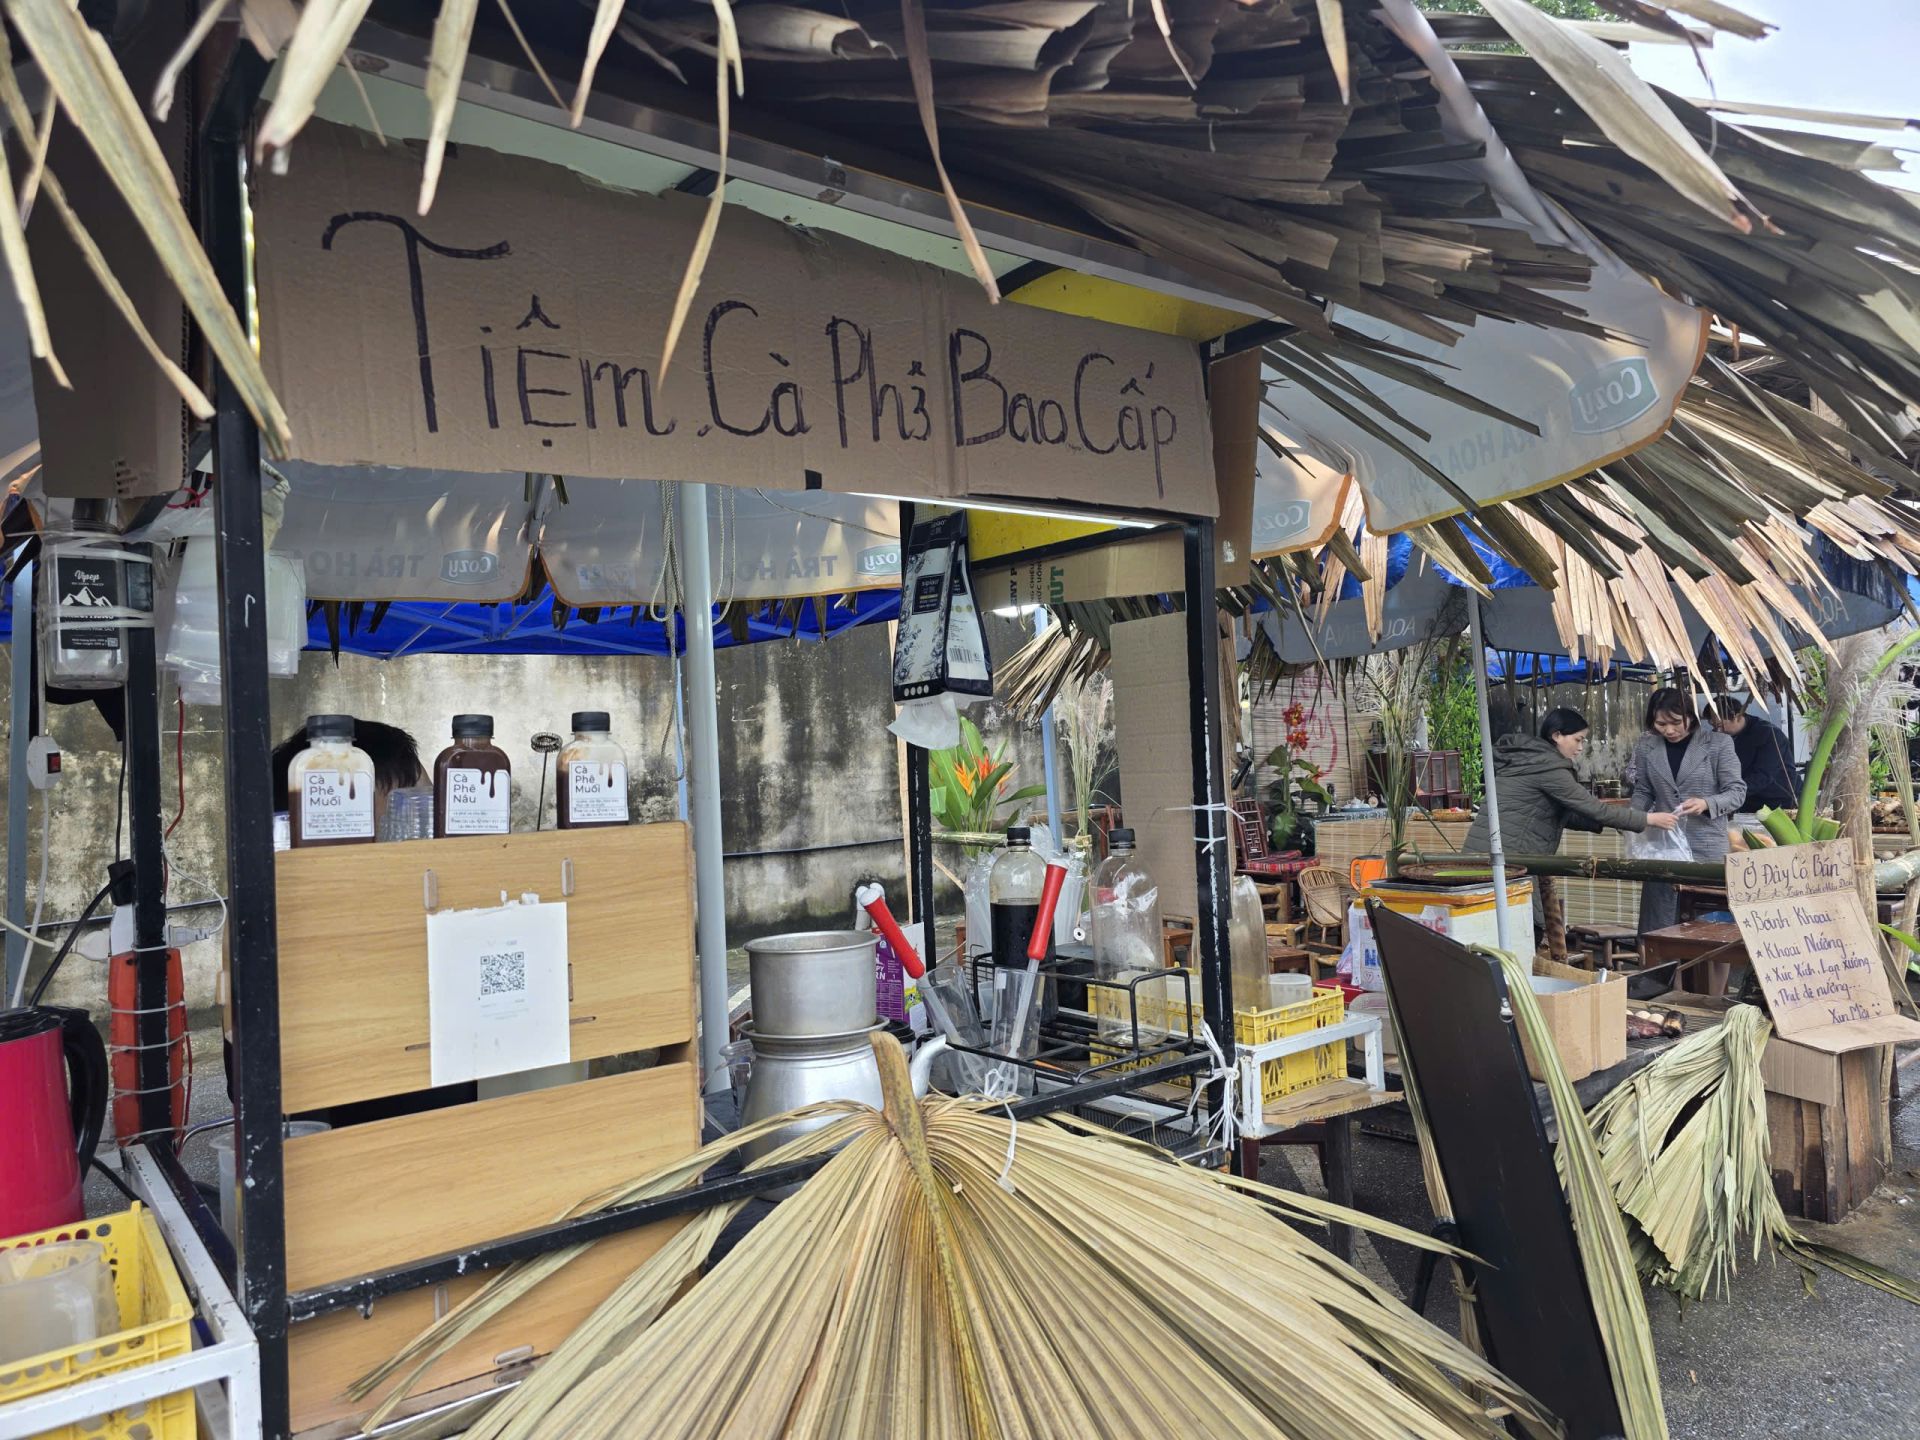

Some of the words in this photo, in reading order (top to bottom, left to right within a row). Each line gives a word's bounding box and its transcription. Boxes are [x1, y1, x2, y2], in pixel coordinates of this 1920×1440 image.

[702, 300, 812, 437] Cà
[949, 326, 1068, 448] Bao
[1074, 351, 1178, 499] Cấp
[574, 765, 588, 775] Cà
[308, 775, 325, 785] Cà
[453, 773, 468, 783] Cà
[575, 775, 596, 784] Phê
[309, 786, 335, 796] Phê
[453, 784, 476, 793] Phê
[575, 784, 601, 793] Muối
[309, 796, 341, 807] Muối
[1812, 853, 1840, 877] Bán
[1750, 908, 1791, 935] Bánh
[1763, 941, 1801, 959] Khoai
[1827, 1008, 1849, 1025] Xin
